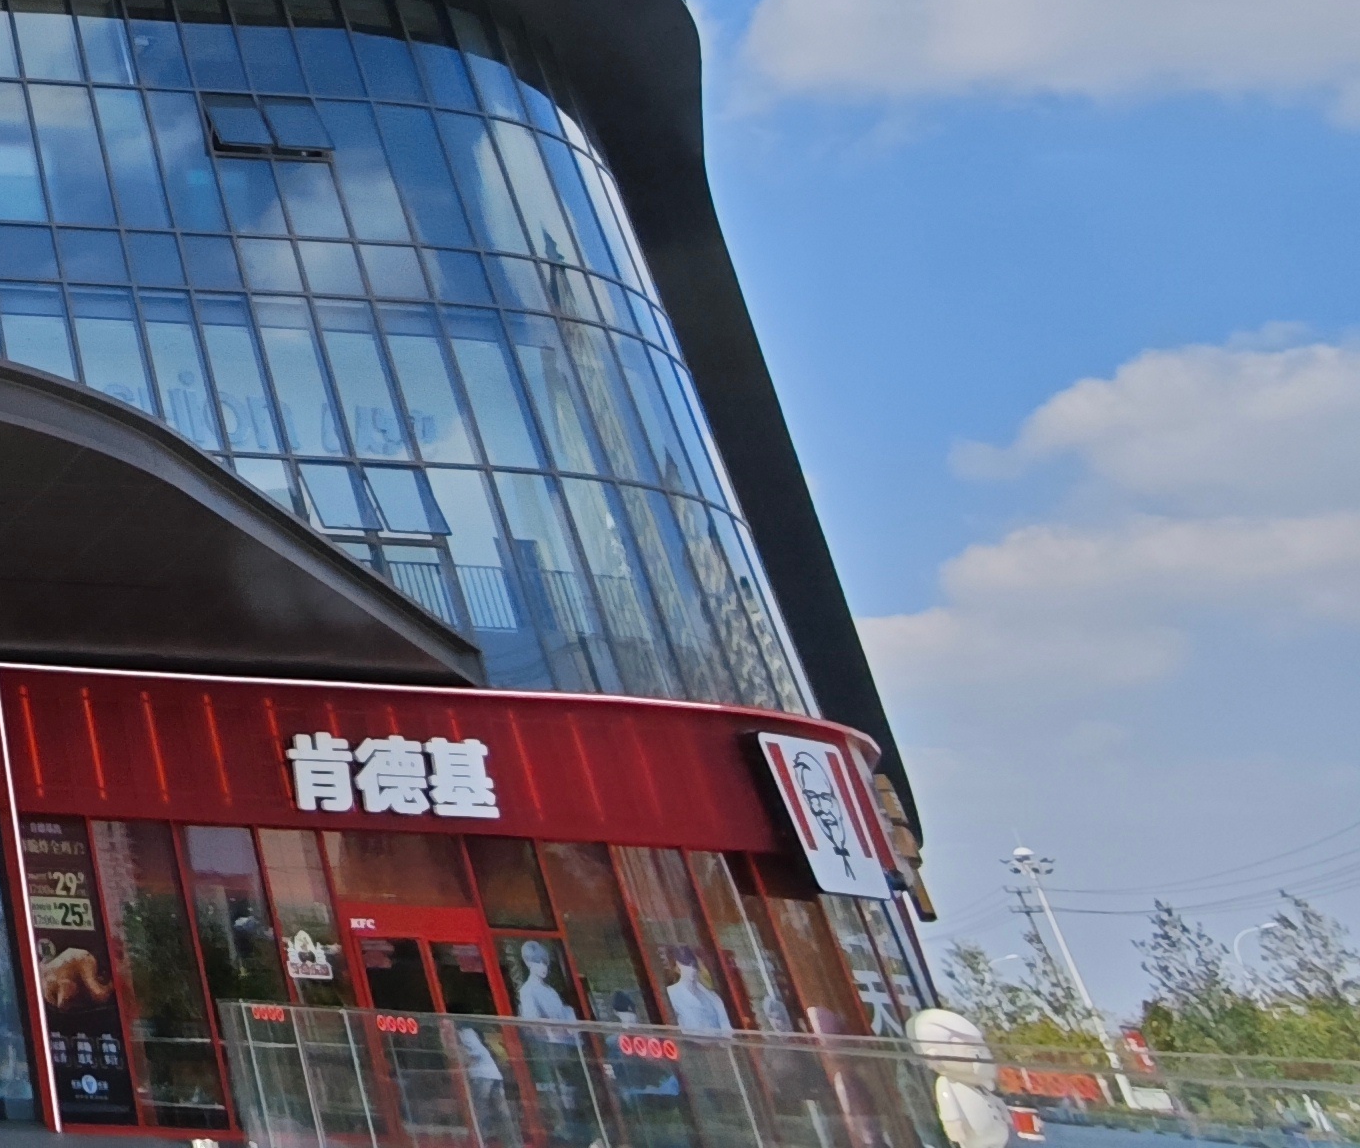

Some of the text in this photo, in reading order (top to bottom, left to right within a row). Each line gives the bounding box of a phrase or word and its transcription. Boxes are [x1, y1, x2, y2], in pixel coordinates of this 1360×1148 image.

[287, 733, 500, 818] 肯德基
[349, 917, 376, 929] KFC
